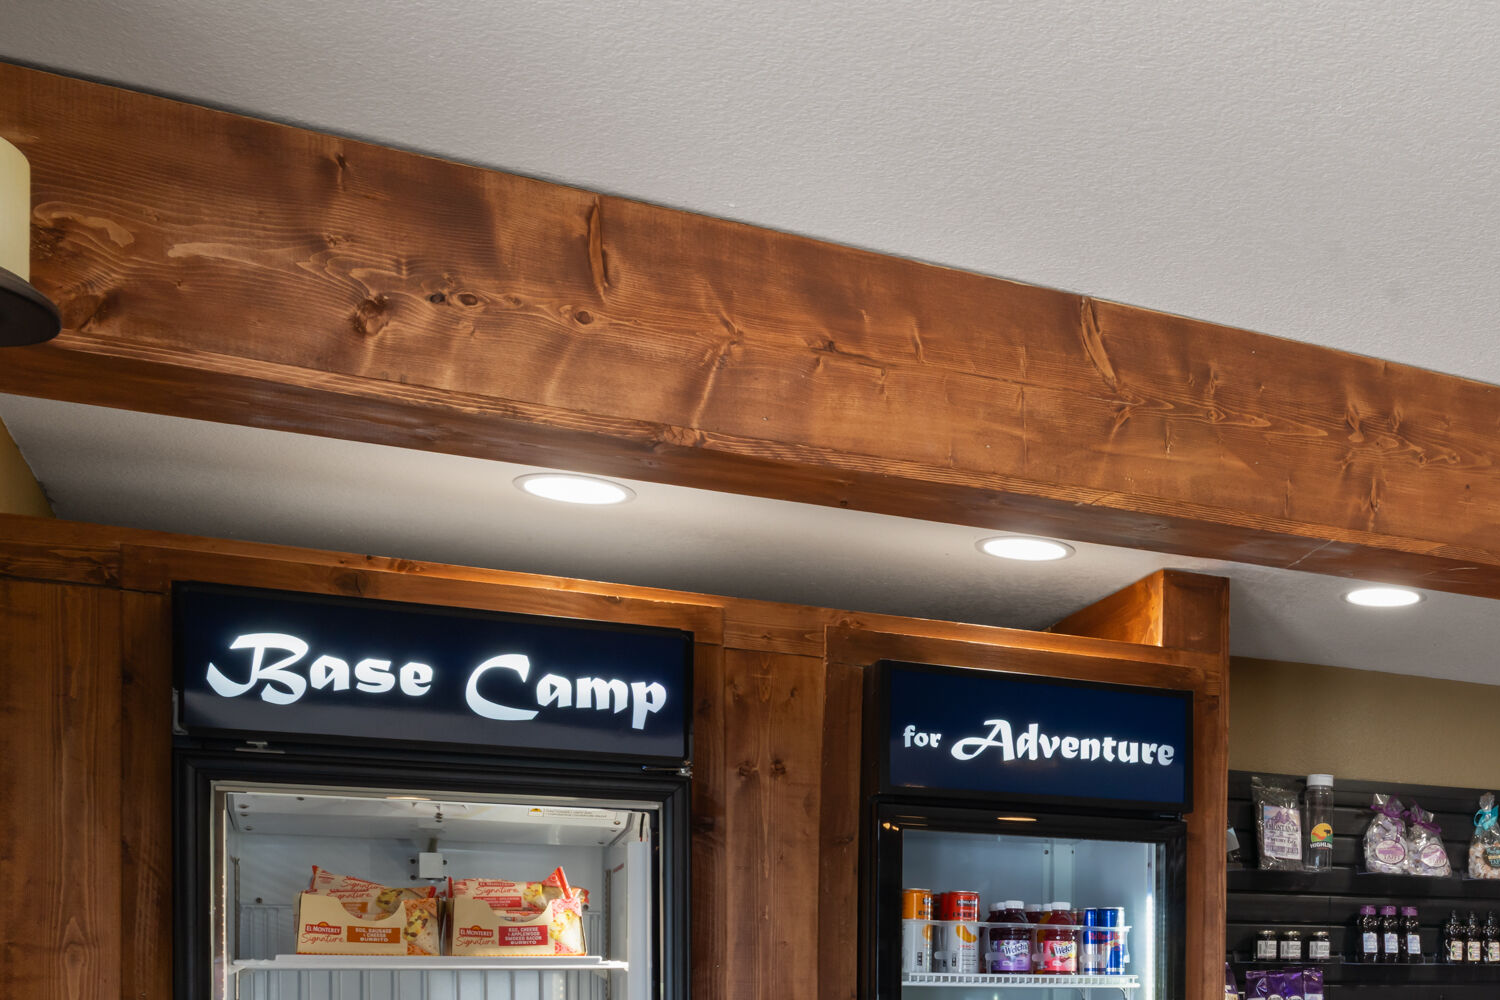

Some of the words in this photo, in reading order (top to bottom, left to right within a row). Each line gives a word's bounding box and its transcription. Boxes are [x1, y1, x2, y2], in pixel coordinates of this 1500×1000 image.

[206, 632, 433, 705] Base
[465, 653, 667, 730] Camp
[904, 725, 941, 748] for
[951, 719, 1174, 766] Adventure
